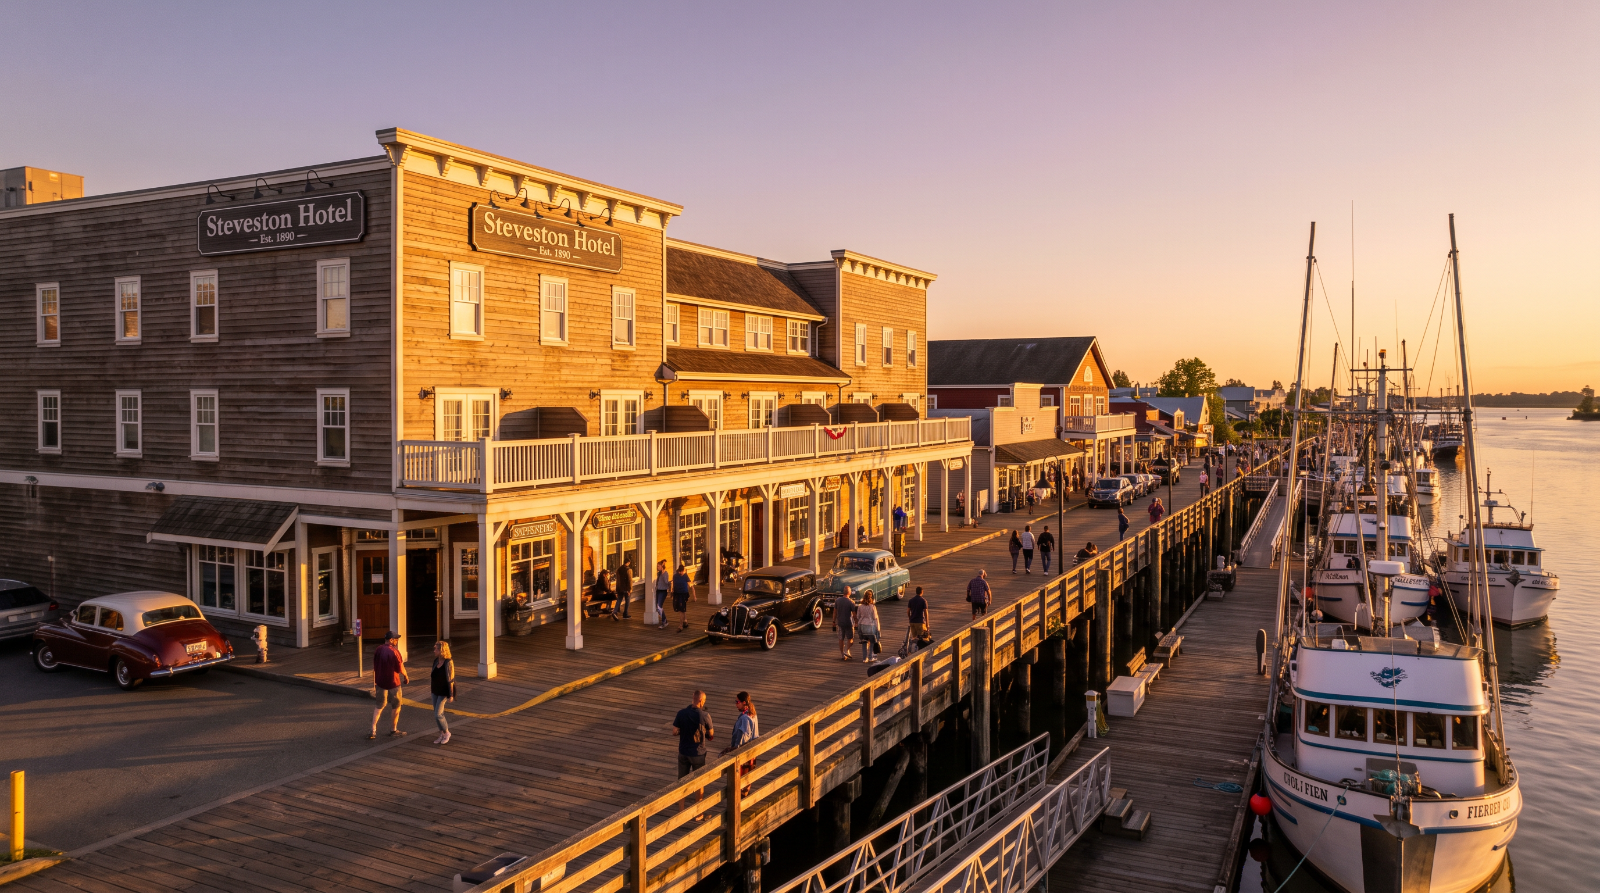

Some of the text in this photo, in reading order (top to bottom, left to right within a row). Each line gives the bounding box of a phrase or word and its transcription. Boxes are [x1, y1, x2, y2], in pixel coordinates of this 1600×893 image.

[206, 197, 353, 237] Steveston Hotel
[259, 231, 295, 244] Est. 1890
[483, 211, 616, 256] Steveston Hotel
[539, 245, 571, 260] Est. 1890
[1304, 782, 1328, 802] FIEN
